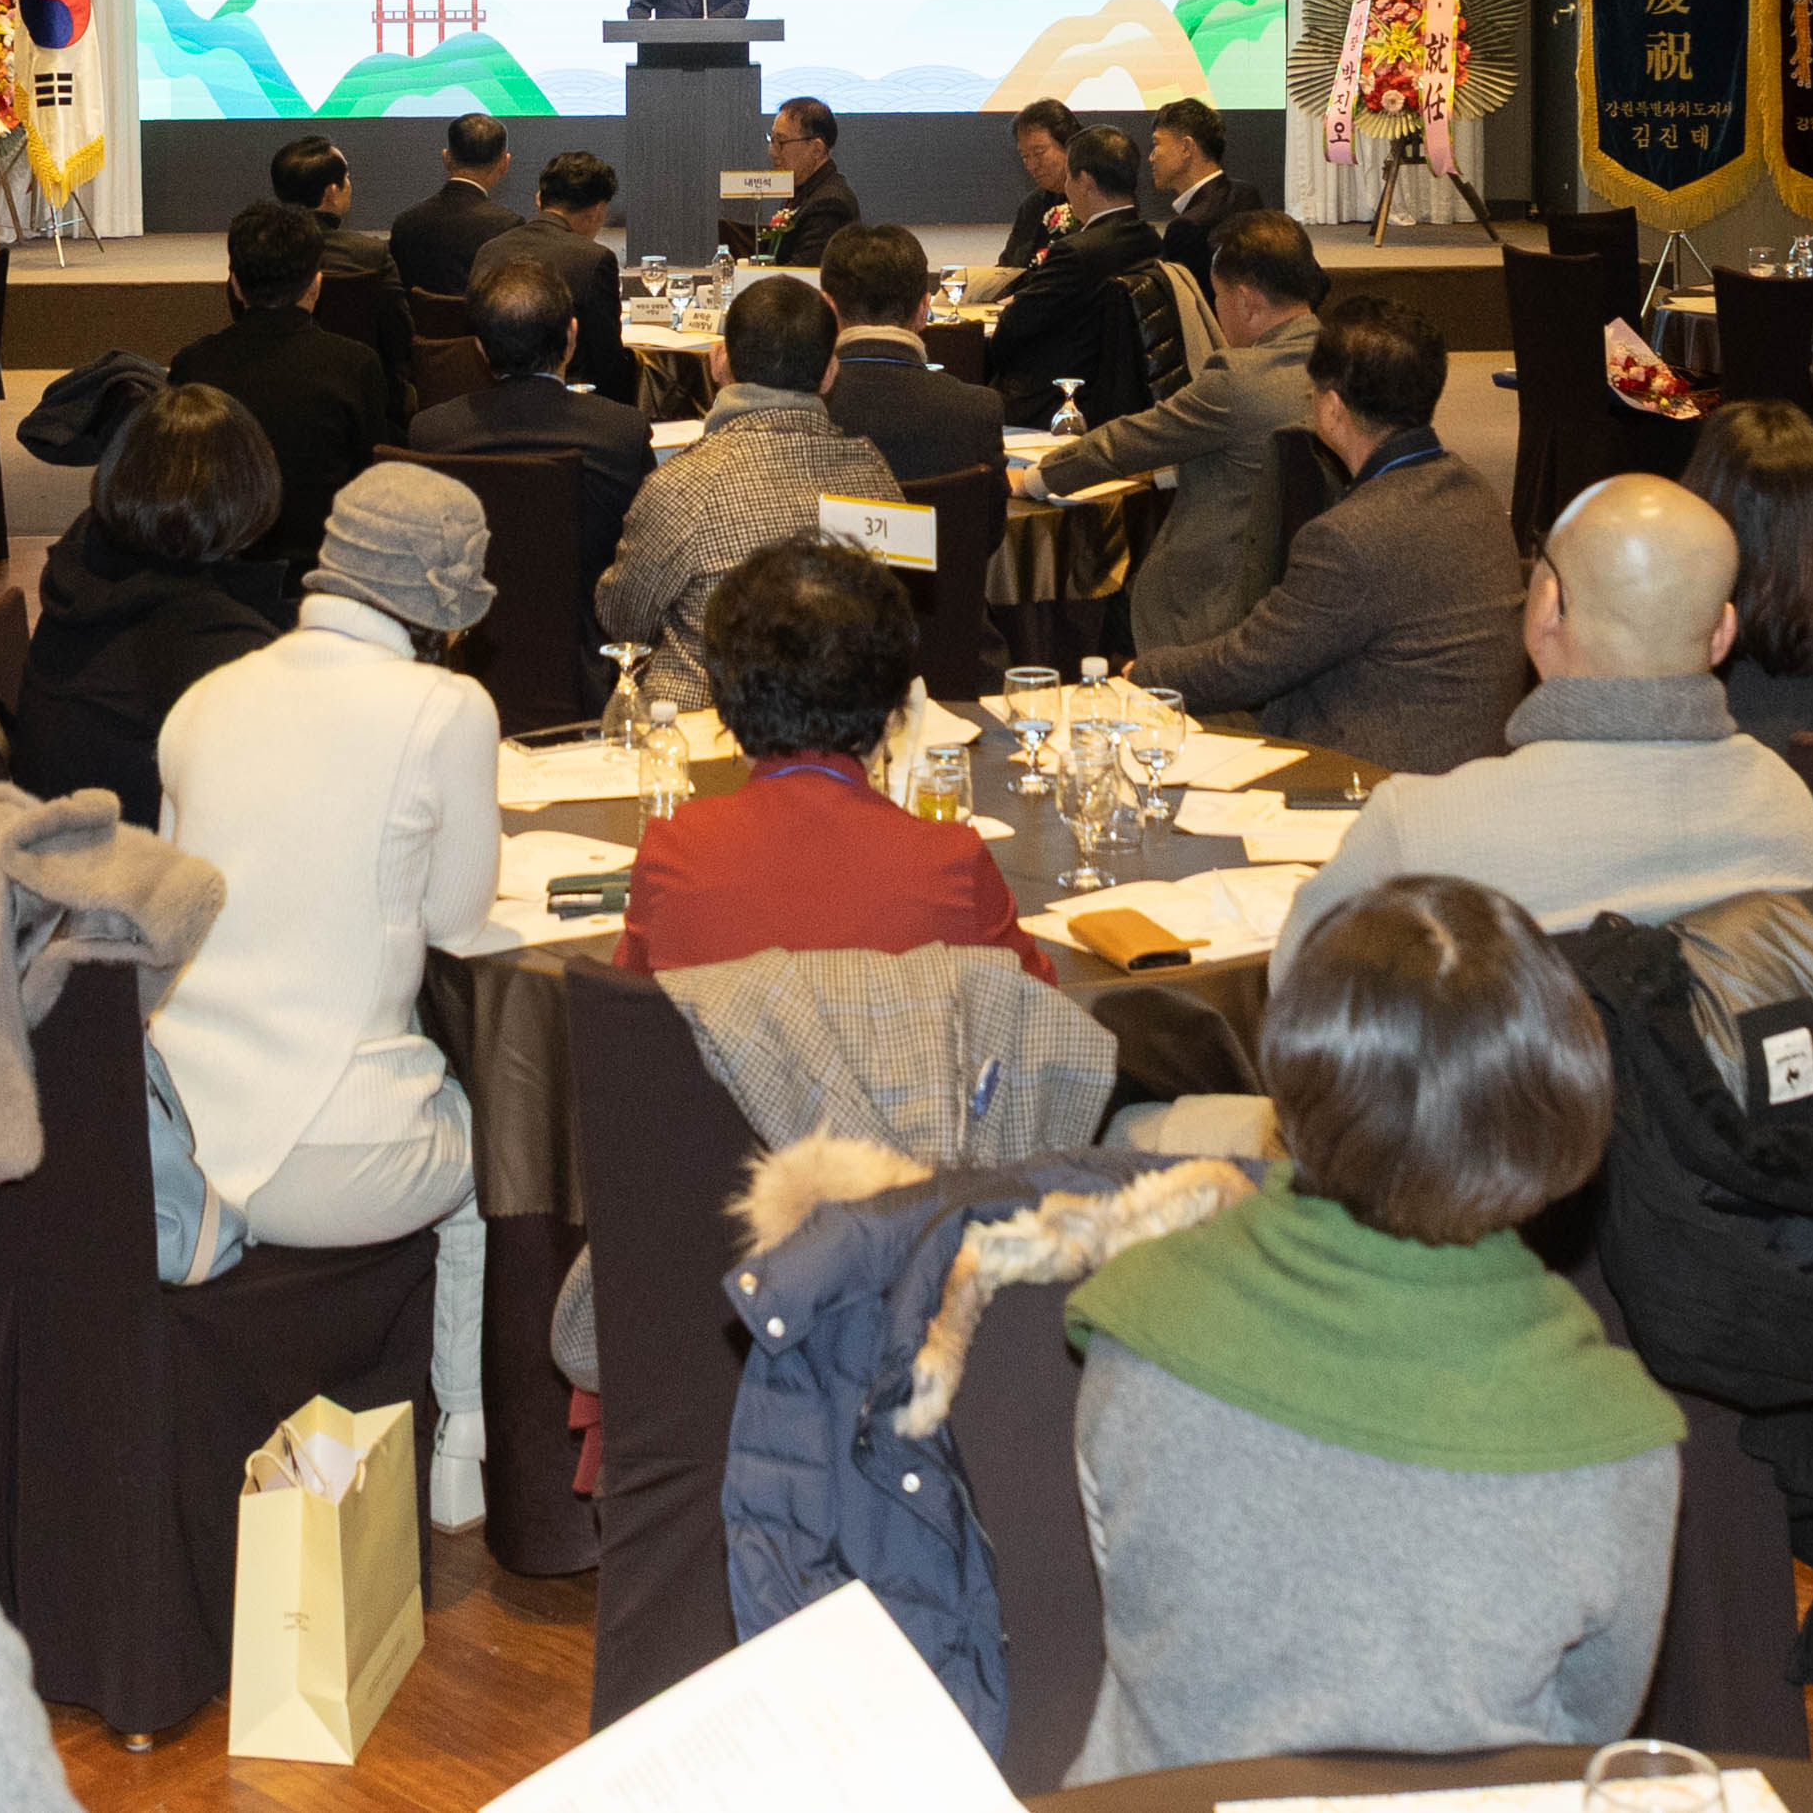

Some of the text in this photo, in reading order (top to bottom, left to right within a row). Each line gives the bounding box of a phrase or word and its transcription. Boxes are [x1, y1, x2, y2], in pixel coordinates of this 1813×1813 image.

[1330, 62, 1356, 144] 박진오
[1604, 100, 1734, 118] 강원특별자치도지사
[1631, 123, 1710, 151] 김진태
[744, 177, 772, 189] 내빈석
[864, 517, 888, 539] 3기
